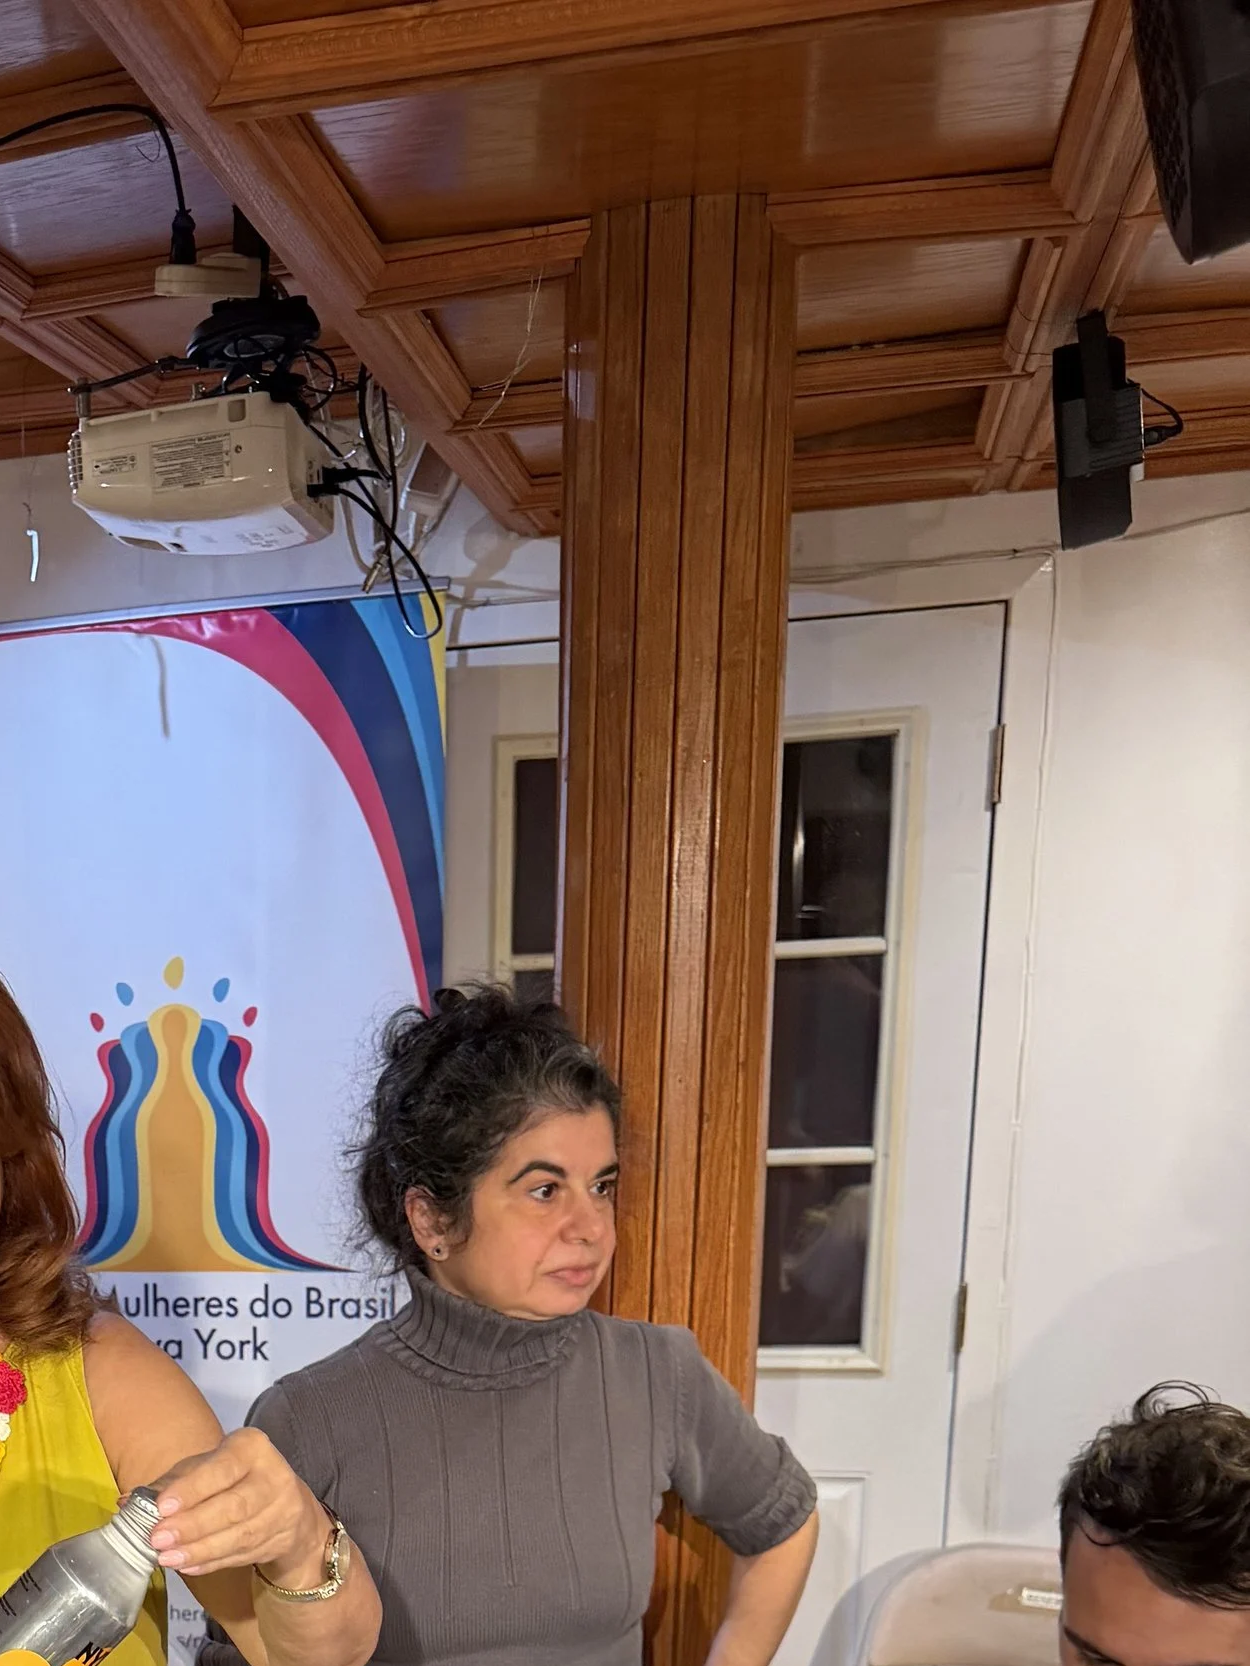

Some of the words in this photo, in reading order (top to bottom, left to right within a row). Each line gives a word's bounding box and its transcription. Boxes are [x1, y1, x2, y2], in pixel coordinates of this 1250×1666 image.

[249, 1283, 292, 1319] do
[305, 1284, 396, 1319] Brasil
[193, 1326, 269, 1361] York
